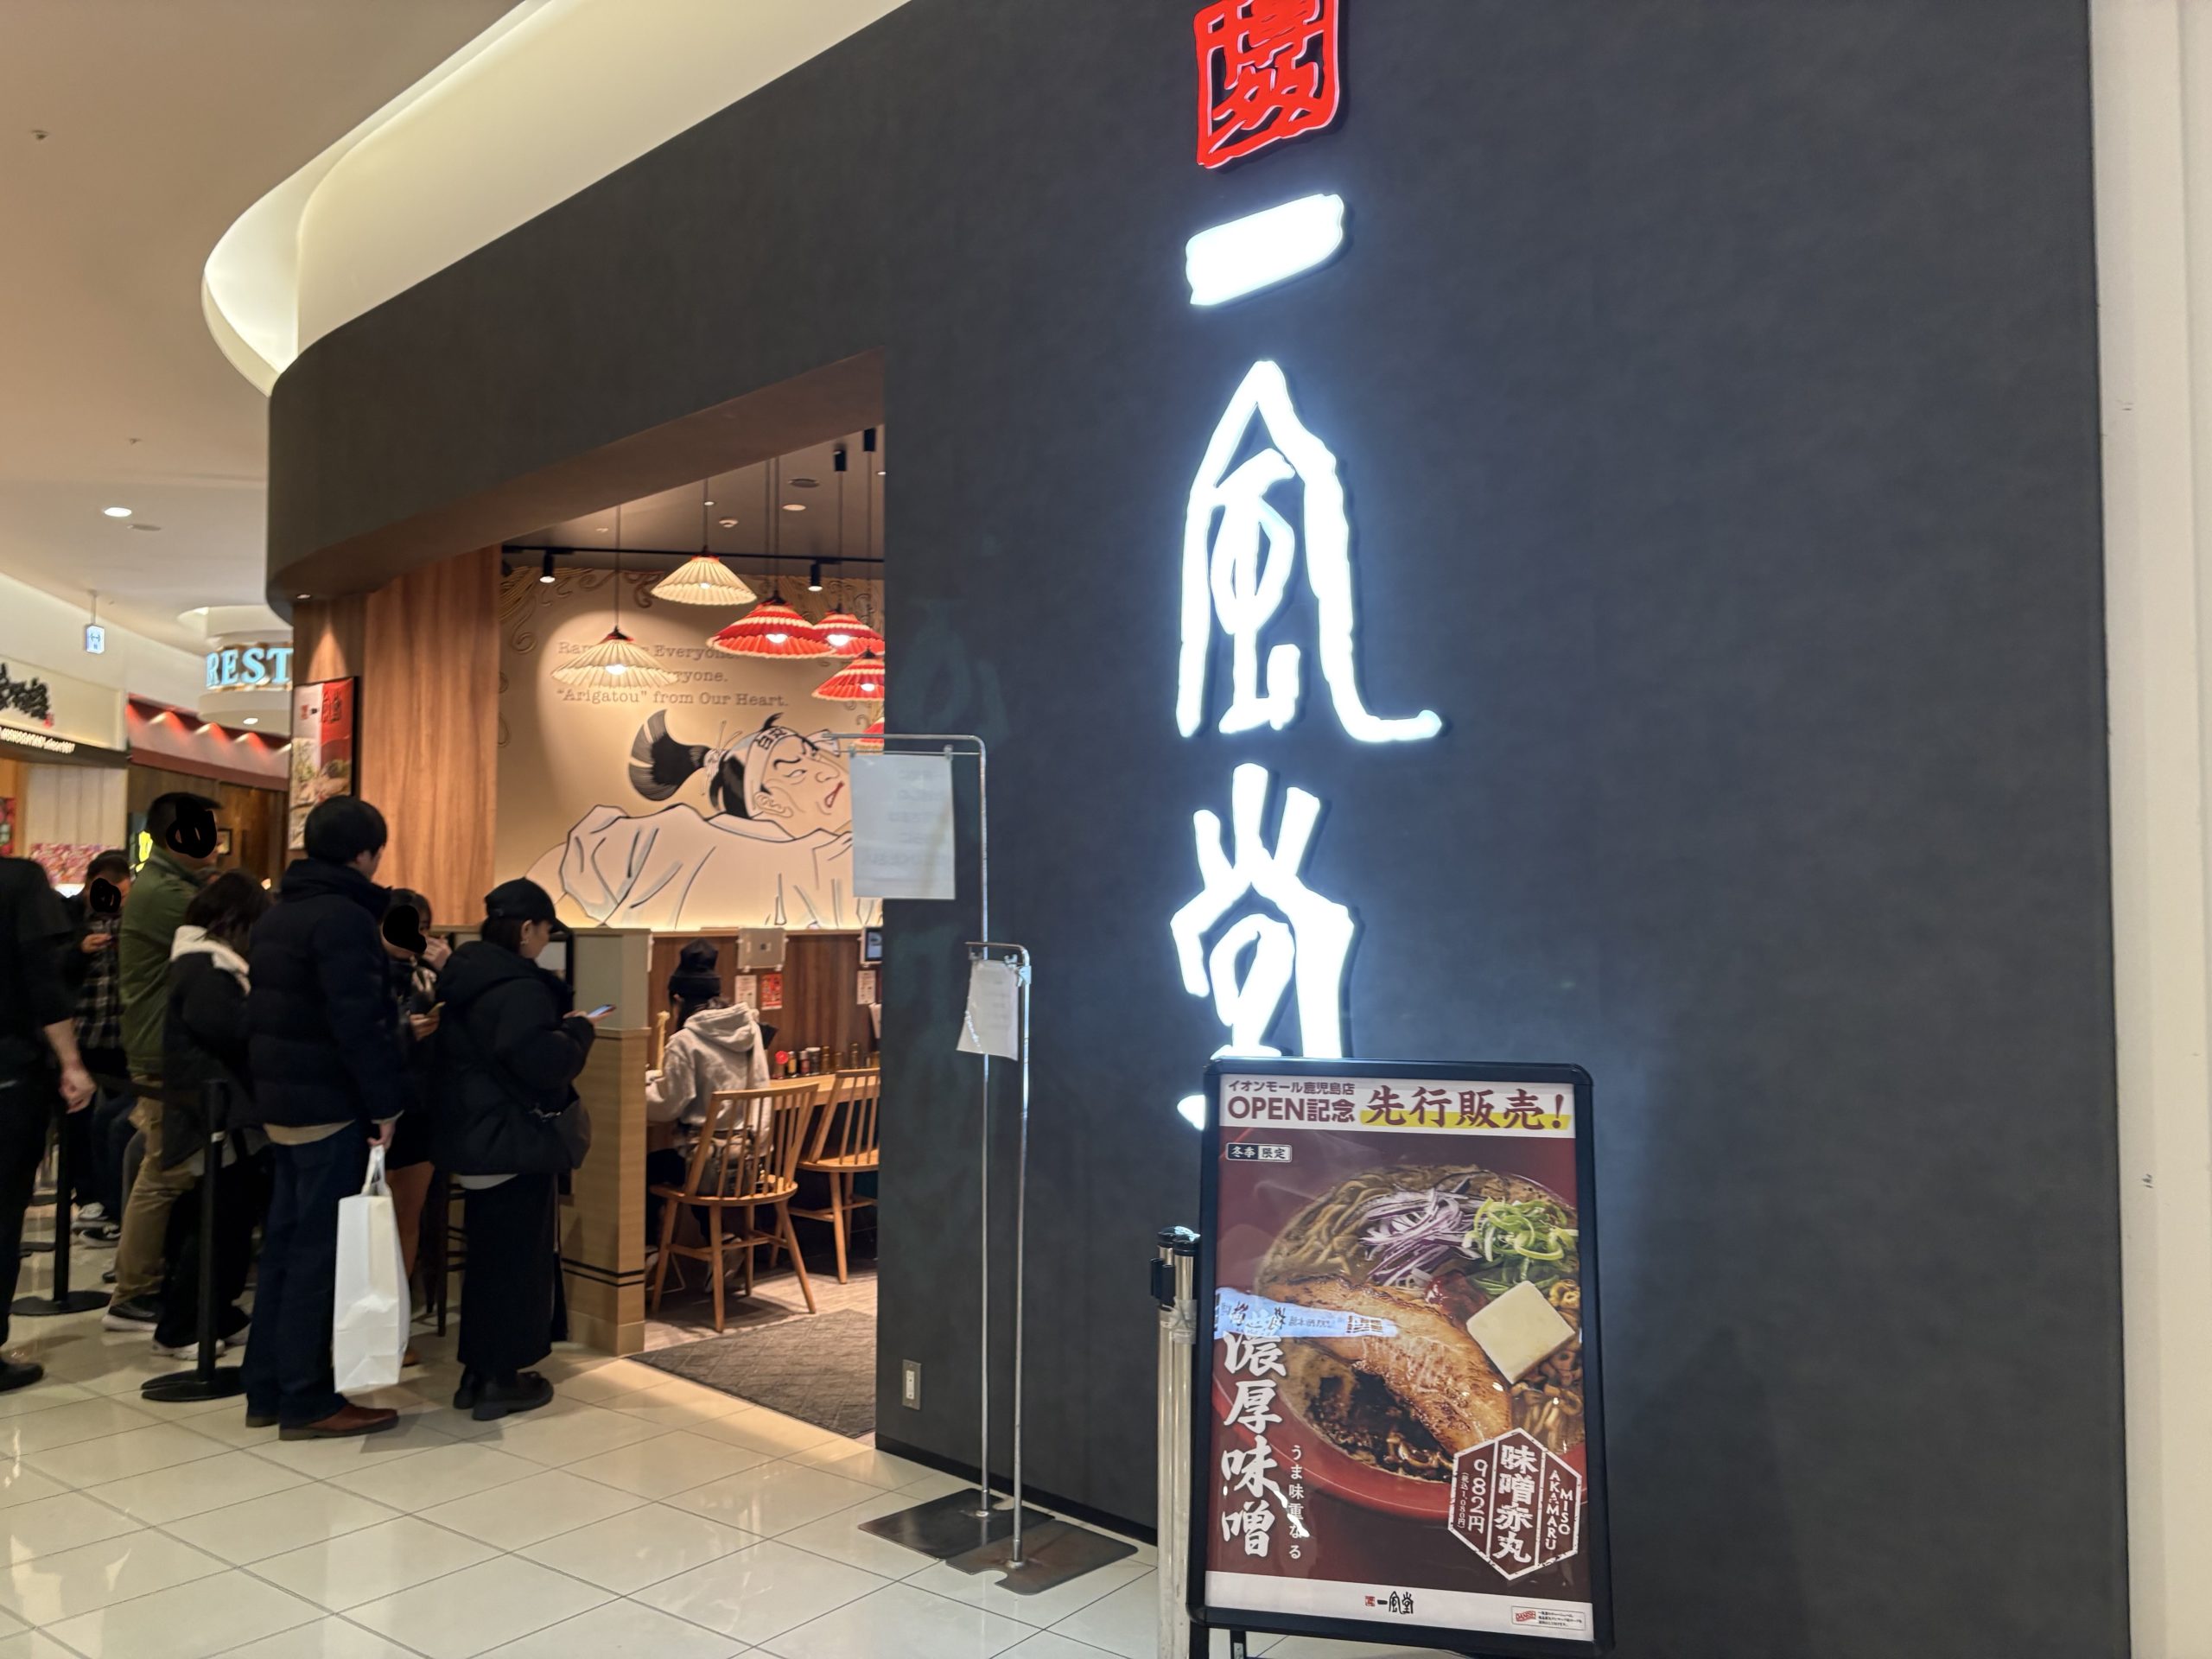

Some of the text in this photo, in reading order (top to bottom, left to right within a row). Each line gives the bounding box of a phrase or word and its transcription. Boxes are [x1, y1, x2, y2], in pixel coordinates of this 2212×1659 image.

[206, 647, 294, 687] REST
[653, 691, 694, 704] from
[699, 692, 731, 705] Our
[736, 693, 788, 707] Heart.
[1228, 1084, 1566, 1130] OPEN記念 先行販売!
[1229, 1080, 1356, 1096] イオンモール鹿児島店
[1468, 1459, 1489, 1534] 982円
[1492, 1444, 1539, 1564] 味噌赤丸
[1545, 1470, 1561, 1551] AKAMARU
[1558, 1488, 1573, 1535] MISO
